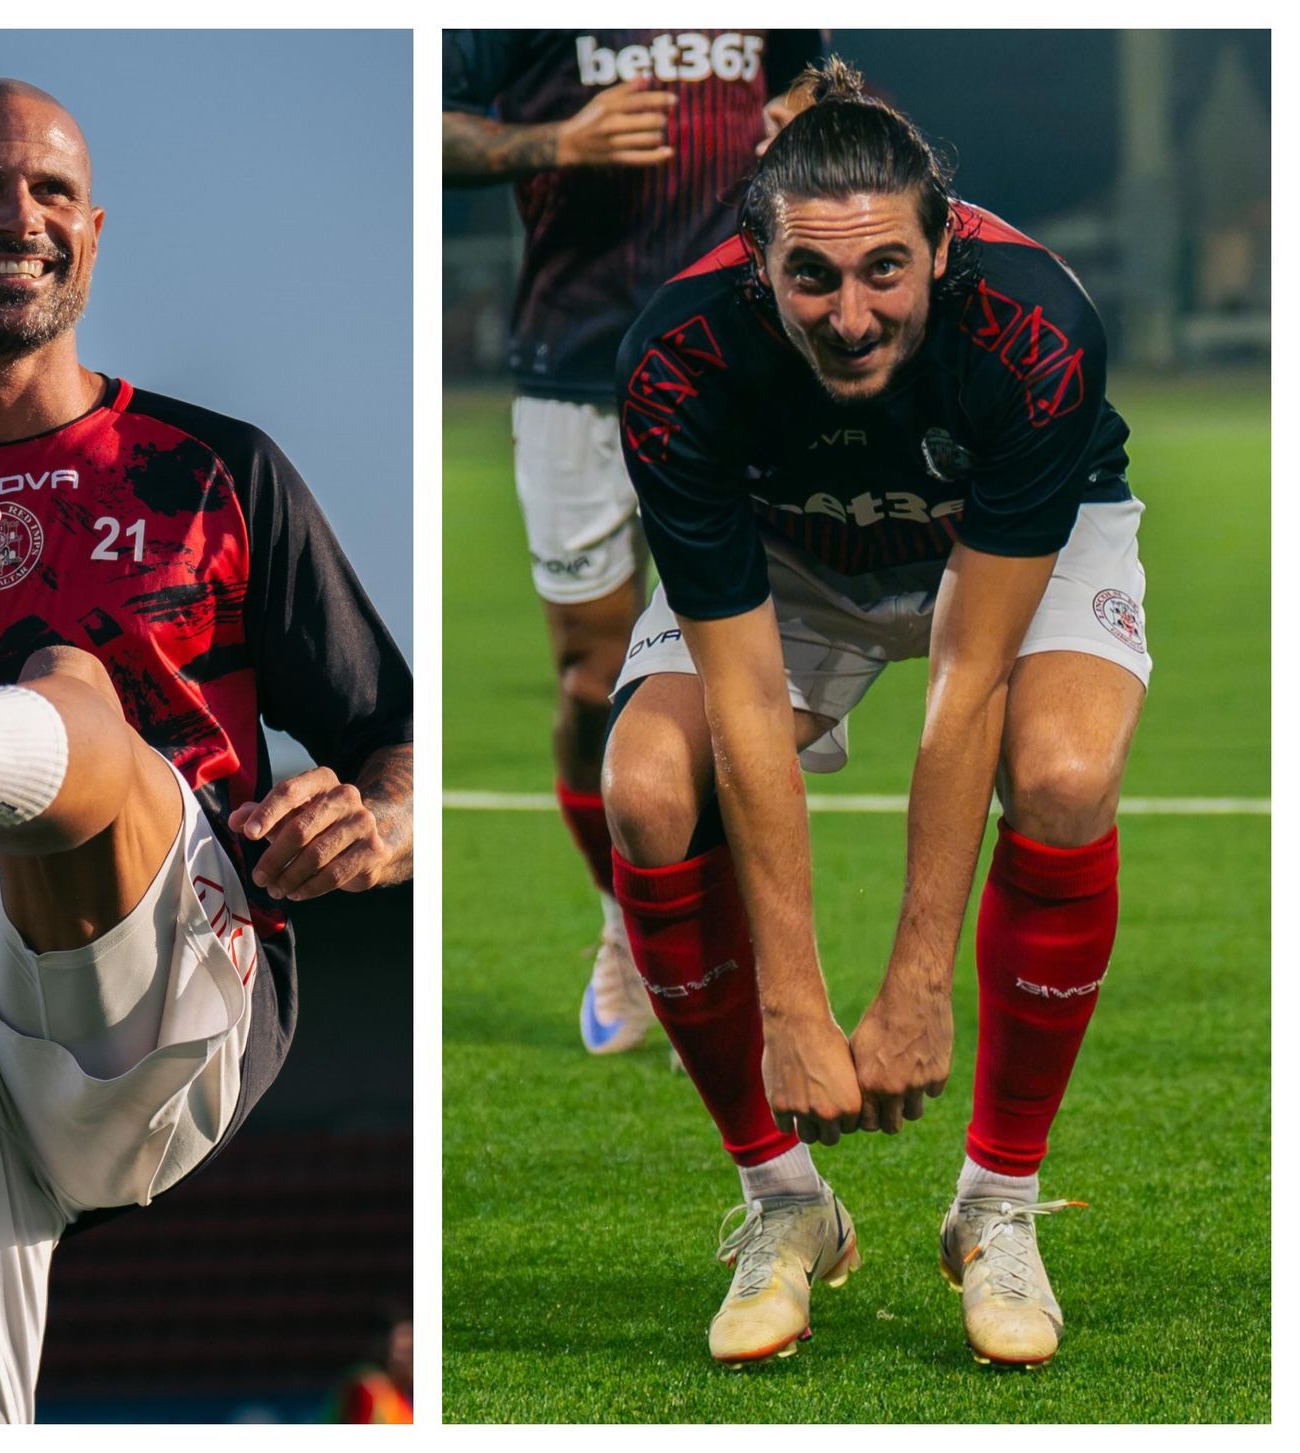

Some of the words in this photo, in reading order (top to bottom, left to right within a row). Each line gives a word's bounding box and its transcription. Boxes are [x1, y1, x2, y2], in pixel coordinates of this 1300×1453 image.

[575, 32, 764, 86] bet365
[8, 505, 33, 524] RED
[29, 524, 41, 557] IMPS
[91, 516, 146, 562] 21
[629, 628, 682, 660] OVA
